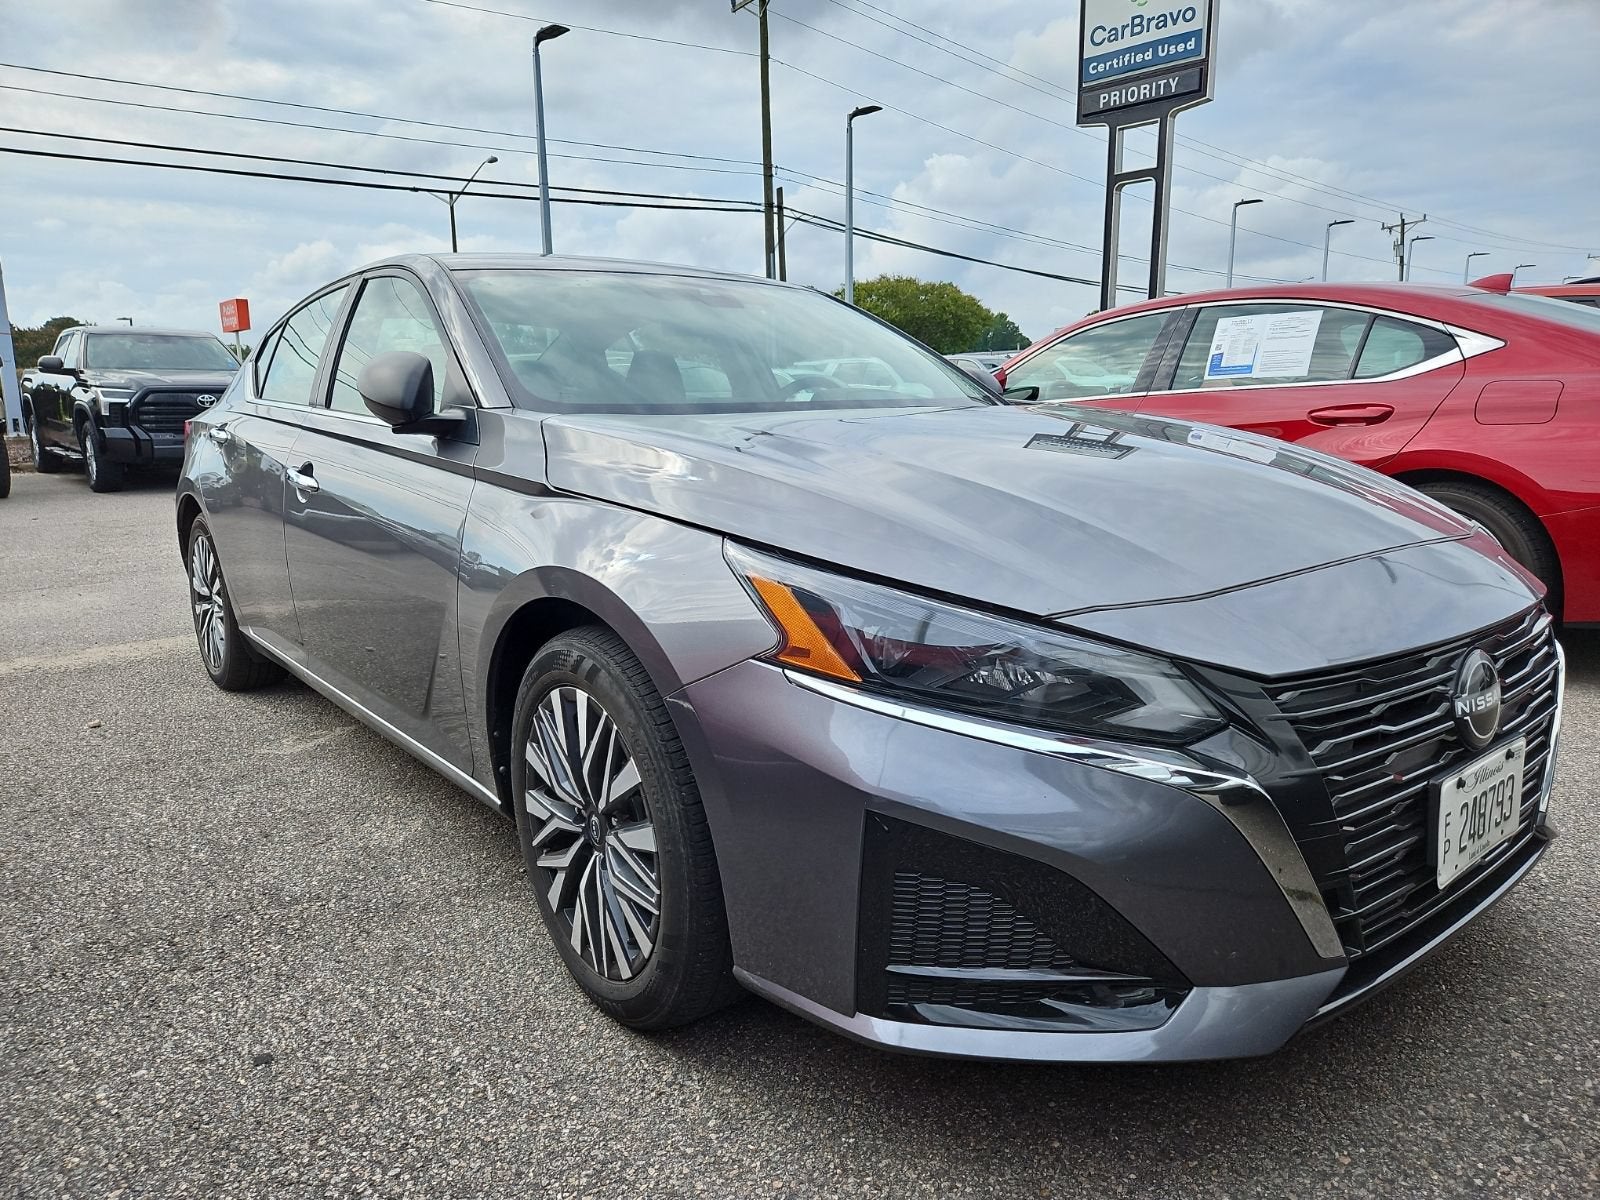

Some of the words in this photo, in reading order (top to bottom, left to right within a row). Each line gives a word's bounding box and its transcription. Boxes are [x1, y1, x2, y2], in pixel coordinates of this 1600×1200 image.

[1090, 6, 1196, 47] CarBravo
[1088, 48, 1153, 74] Certified
[1157, 37, 1196, 57] Used
[1099, 76, 1180, 109] PRIORITY
[1457, 688, 1500, 715] NISSA
[1462, 760, 1505, 793] Illinois
[1458, 773, 1515, 855] 248793
